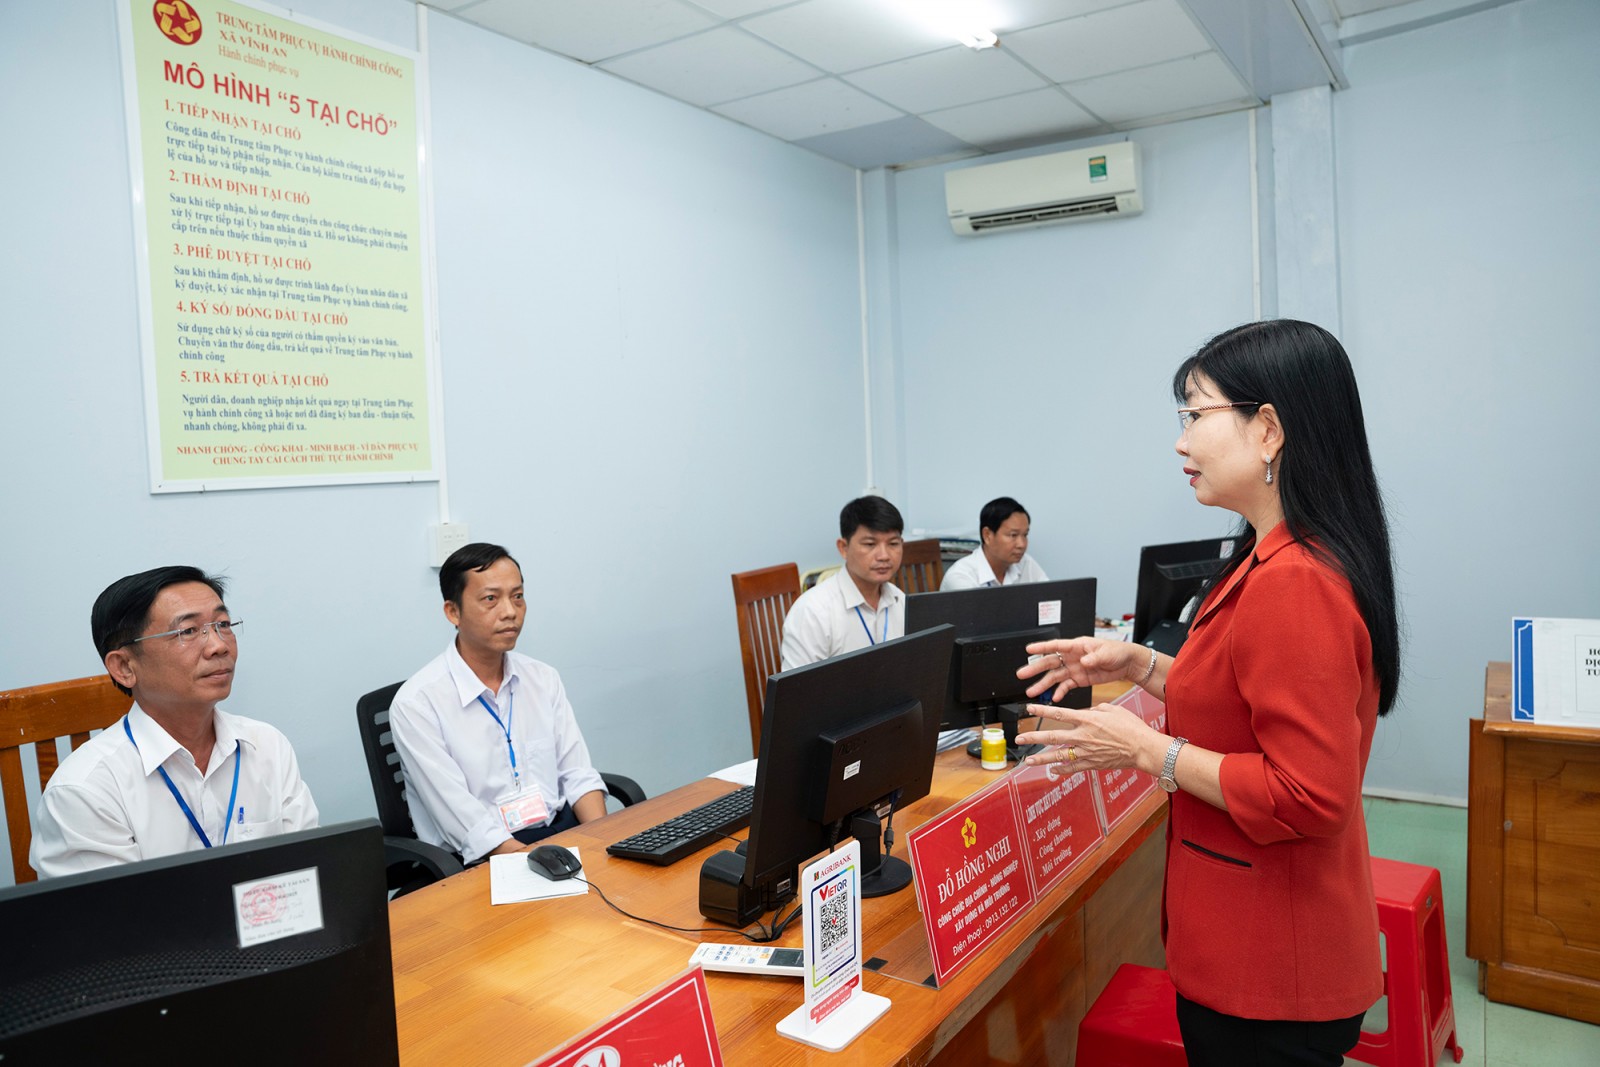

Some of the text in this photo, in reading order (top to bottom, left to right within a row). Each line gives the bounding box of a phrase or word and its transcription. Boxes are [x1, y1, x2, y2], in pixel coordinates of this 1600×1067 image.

[163, 60, 397, 135] MÔ HÌNH “5 TẠI CHỖ”
[820, 853, 852, 878] AGRIBANK
[938, 835, 1011, 903] ĐỖ HỒNG NGHI
[953, 939, 967, 956] Điện
[967, 924, 982, 943] thoại
[985, 895, 1017, 928] 0913.132.122
